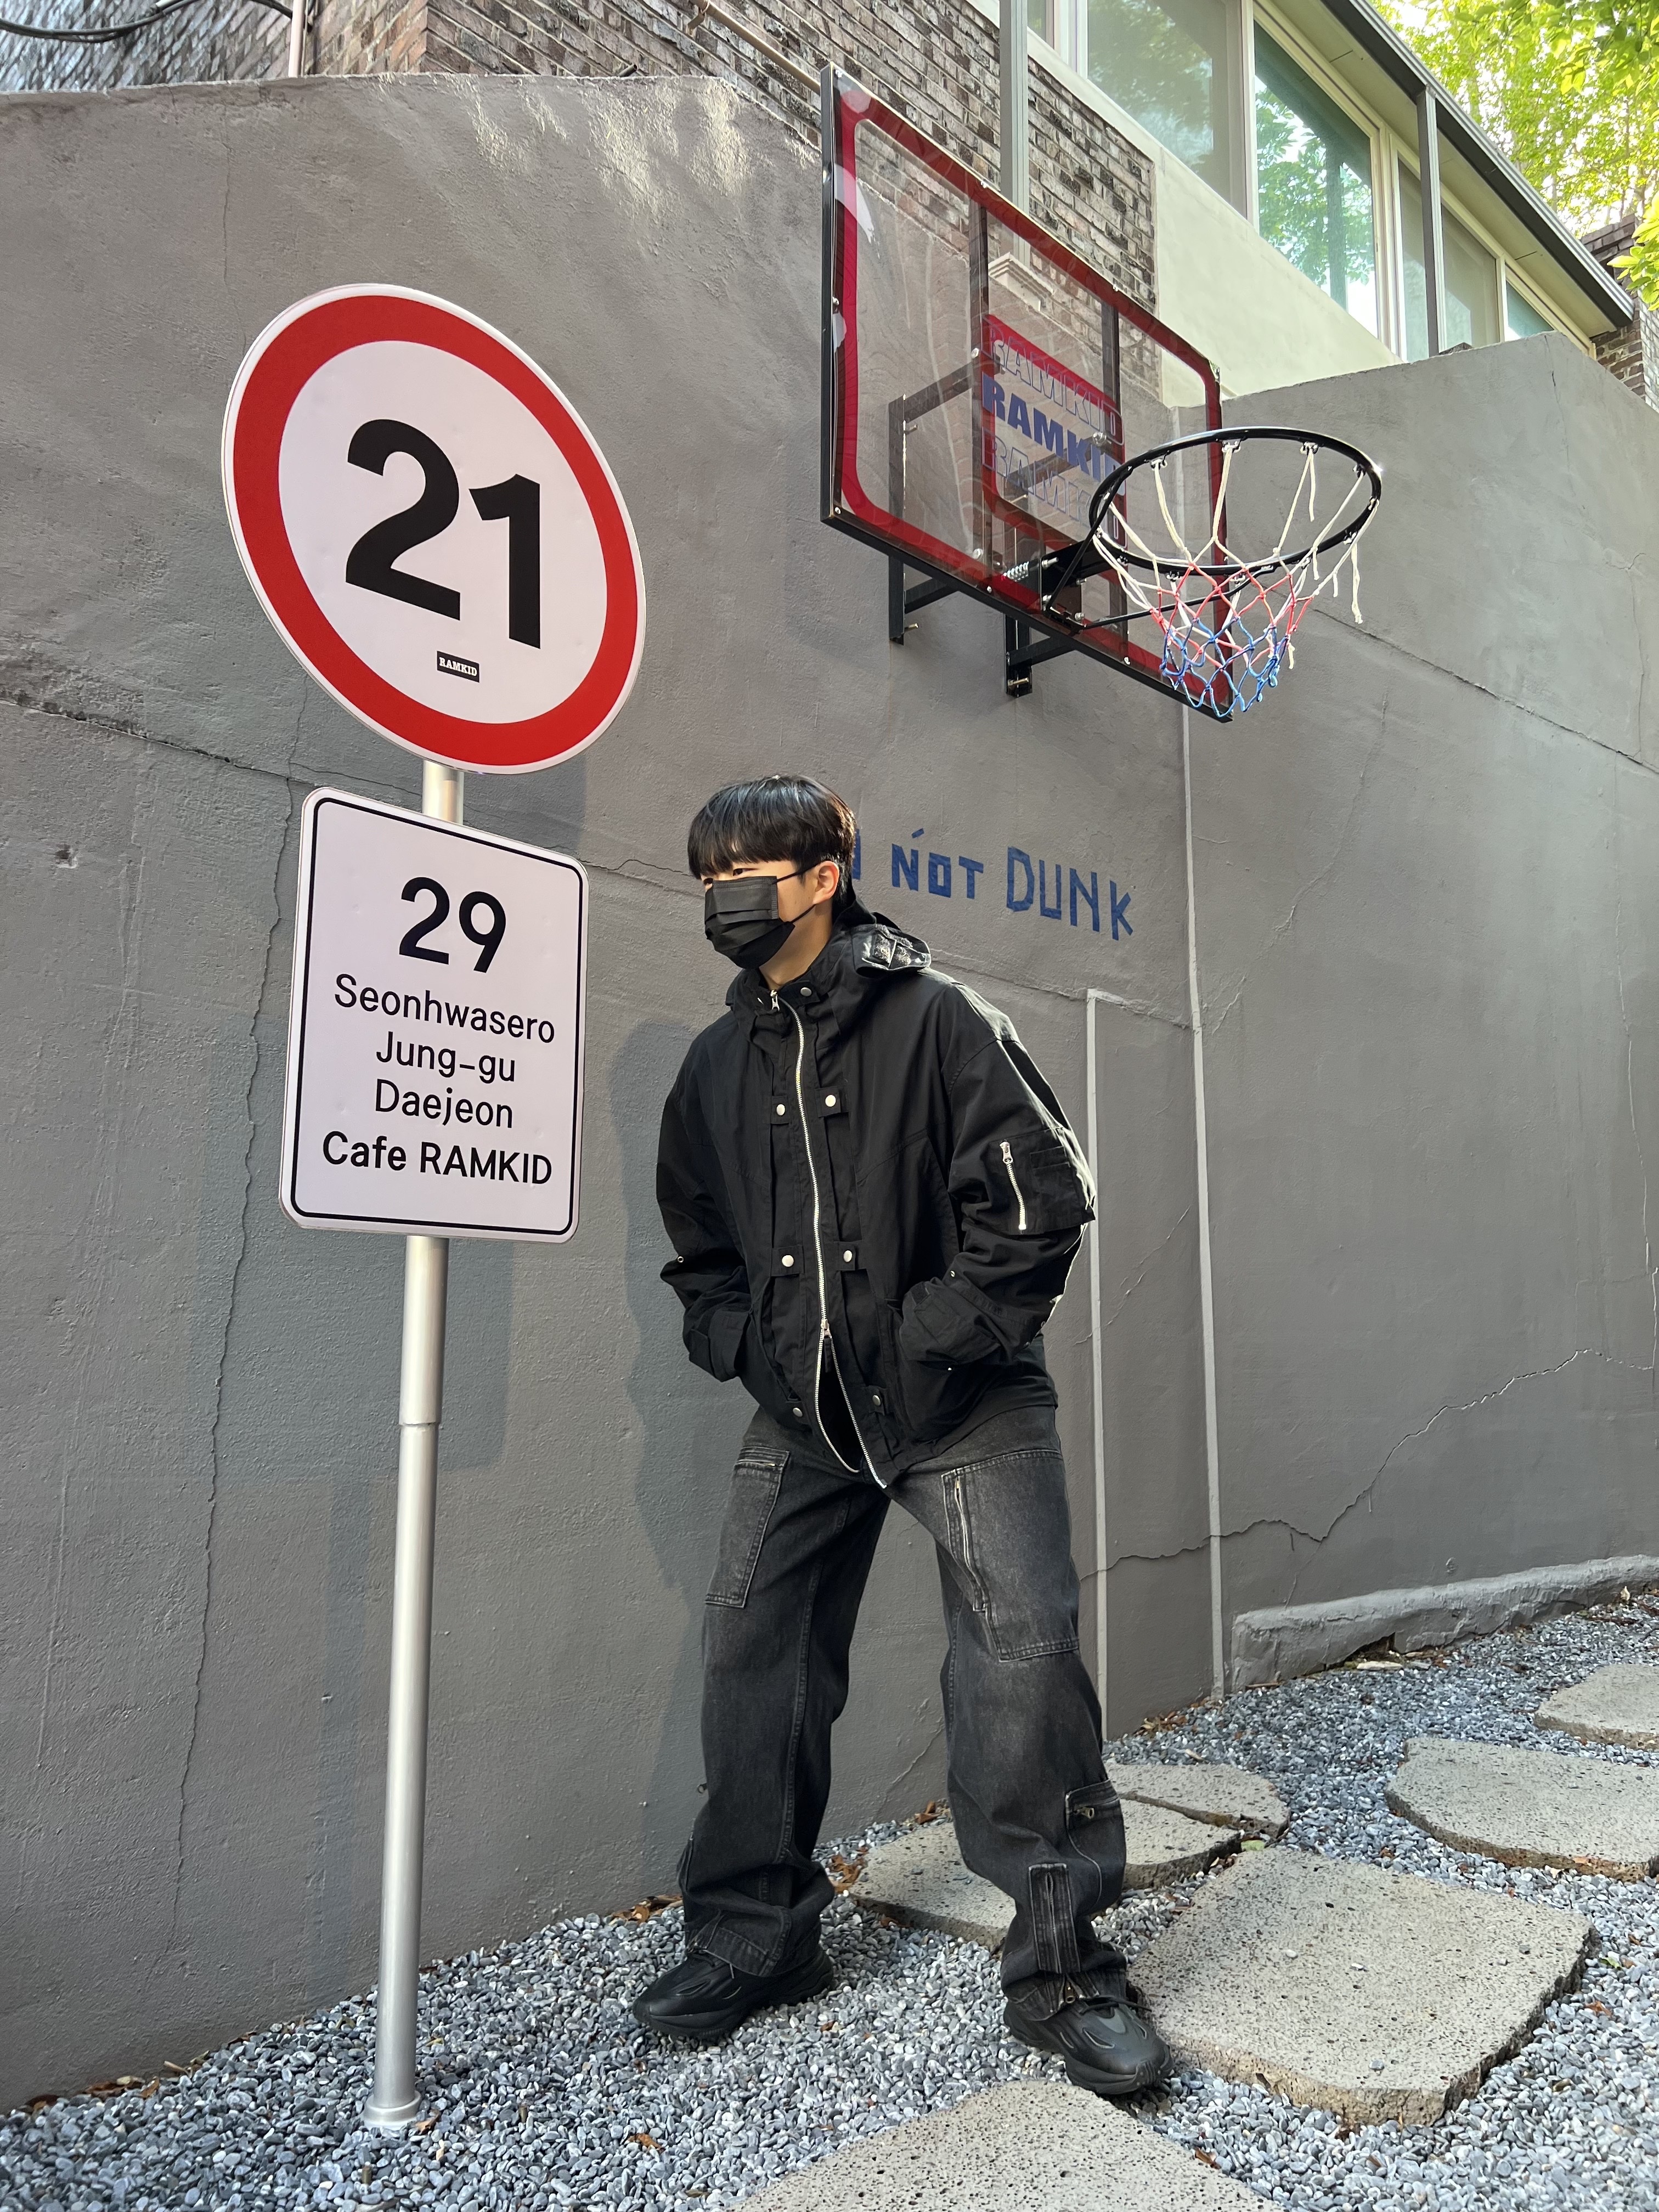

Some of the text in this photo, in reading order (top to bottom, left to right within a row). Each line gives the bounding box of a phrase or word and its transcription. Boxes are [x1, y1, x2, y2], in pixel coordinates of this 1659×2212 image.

[981, 315, 1124, 445] RAMKID
[345, 419, 541, 650] 21
[439, 657, 477, 676] RAMKID
[399, 877, 506, 973] 29
[1006, 847, 1133, 941] DUNK
[335, 973, 555, 1043] Seonhwasero
[376, 1031, 515, 1084] Jung-gu
[375, 1078, 512, 1128] Daejeon
[323, 1131, 552, 1184] Cafe RAMKID
